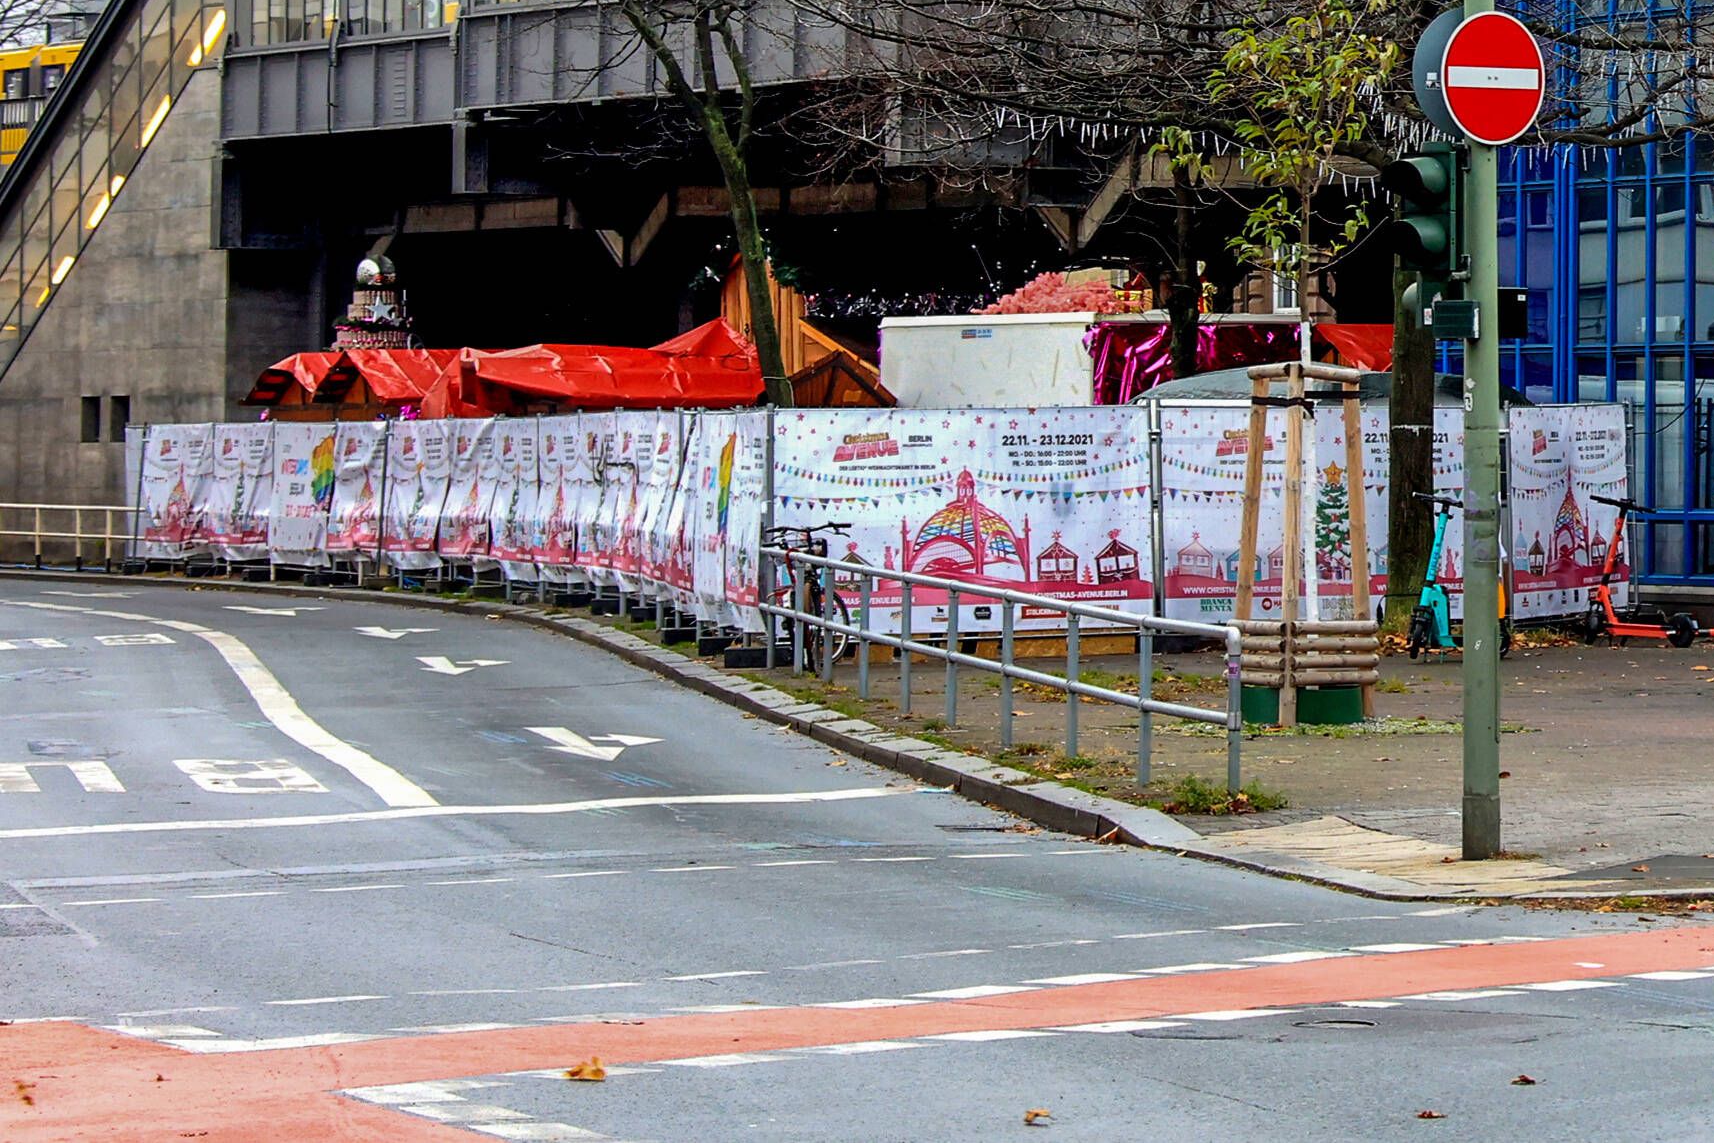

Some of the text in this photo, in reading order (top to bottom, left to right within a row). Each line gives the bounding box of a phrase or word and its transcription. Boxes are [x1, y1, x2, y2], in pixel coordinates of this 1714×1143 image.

[908, 435, 933, 443] BERLIN
[1002, 435, 1030, 446] 22.11.
[1040, 434, 1094, 446] 23.12.2021
[833, 440, 899, 462] AVENUE
